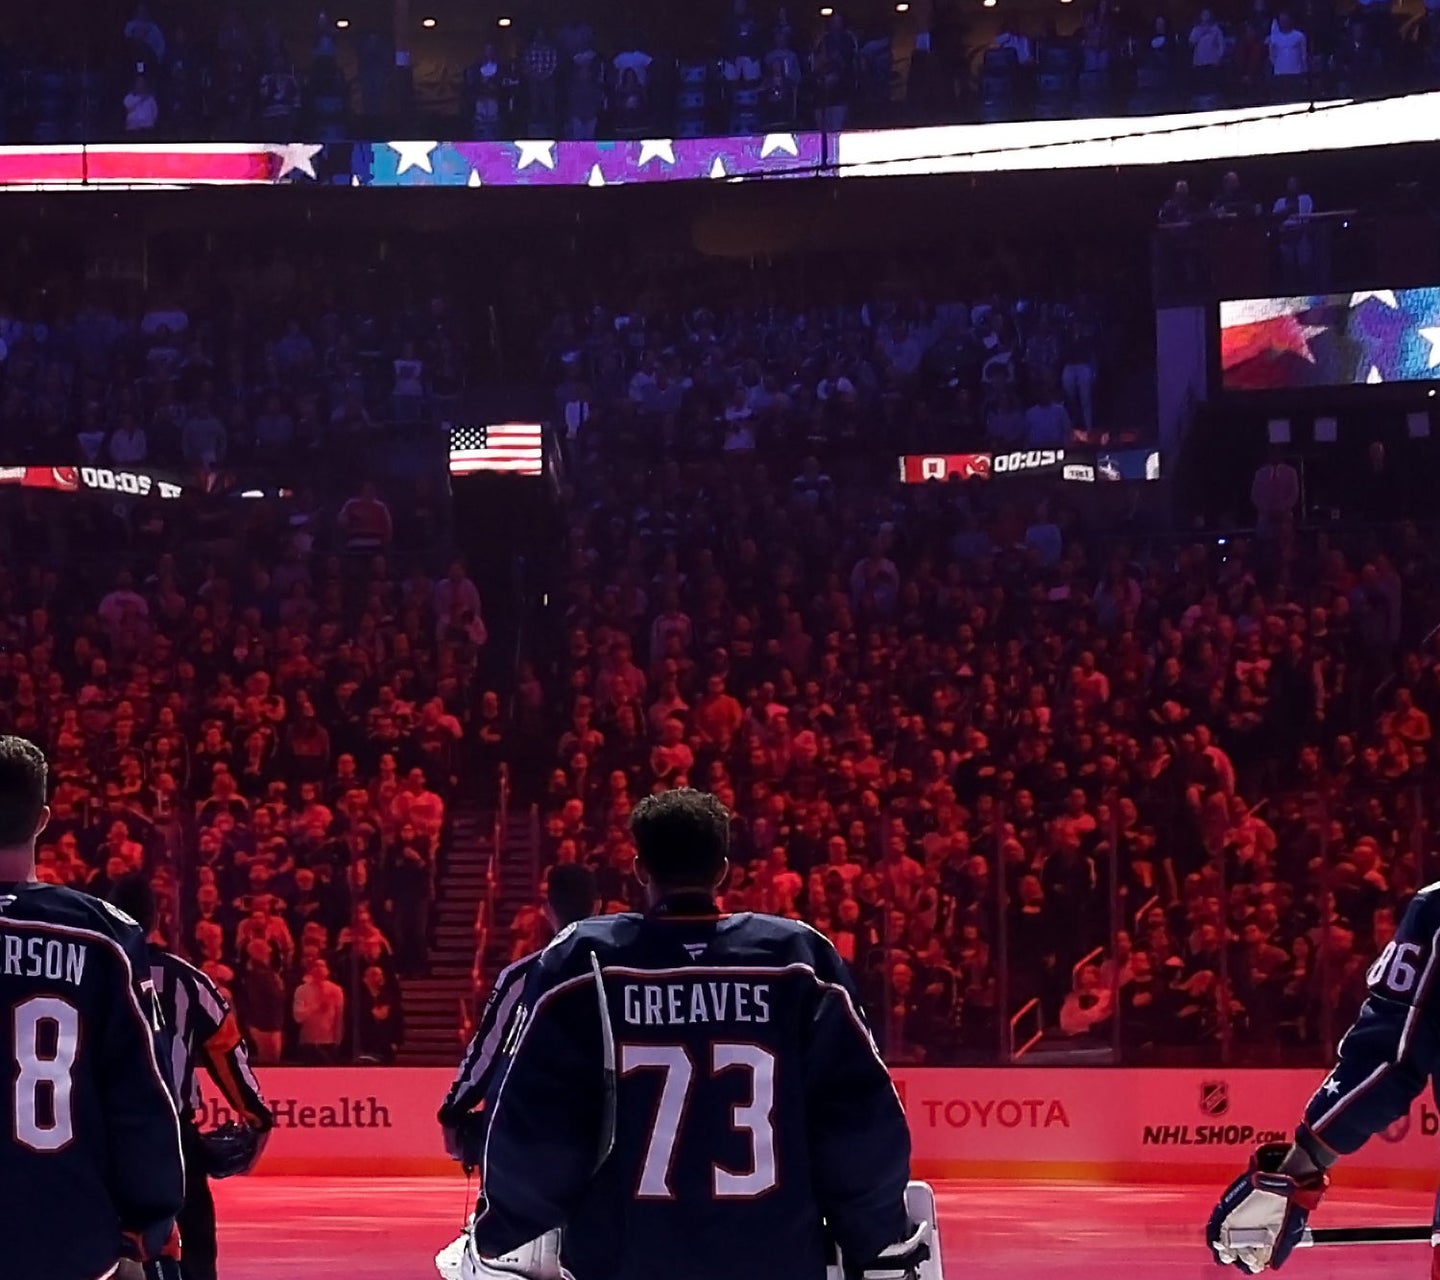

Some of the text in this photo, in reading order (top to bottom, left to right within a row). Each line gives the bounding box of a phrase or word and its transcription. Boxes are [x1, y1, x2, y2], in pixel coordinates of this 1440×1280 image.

[1366, 940, 1421, 993] 86
[624, 982, 771, 1026] GREAVES
[617, 1042, 778, 1202] 73
[922, 1100, 1070, 1128] TOYOTA
